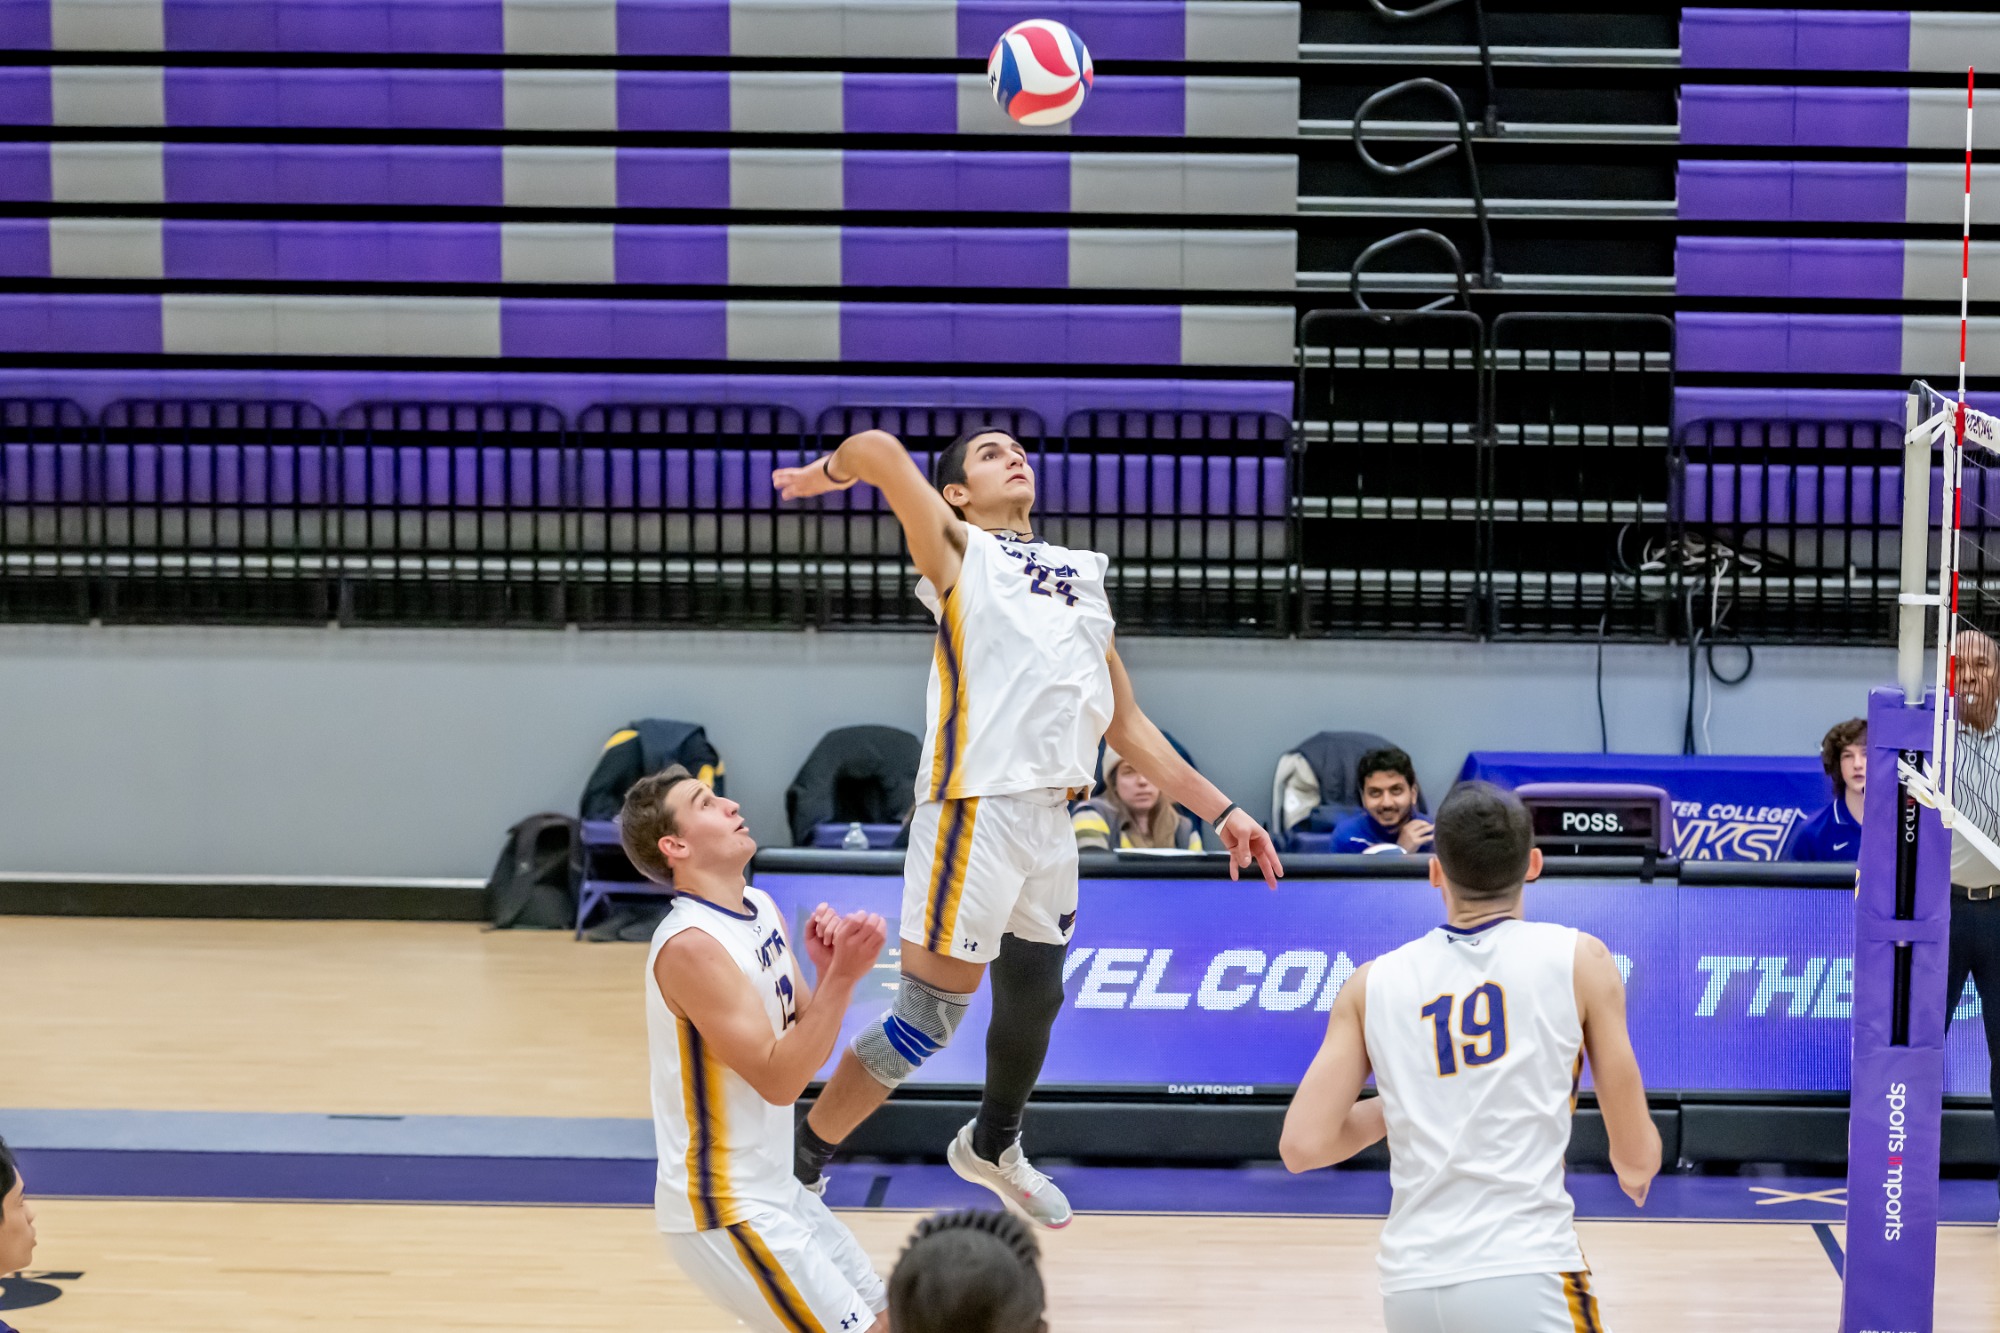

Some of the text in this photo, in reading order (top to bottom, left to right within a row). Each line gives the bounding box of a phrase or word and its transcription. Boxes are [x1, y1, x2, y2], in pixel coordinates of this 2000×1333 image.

[1024, 561, 1079, 607] 24
[1563, 812, 1623, 832] POSS.
[1708, 803, 1793, 824] COLLEGE
[1062, 948, 1356, 1012] ELCO
[1420, 980, 1509, 1078] 19
[1168, 1084, 1254, 1095] DAKTRONICS
[1886, 1082, 1907, 1152] sports
